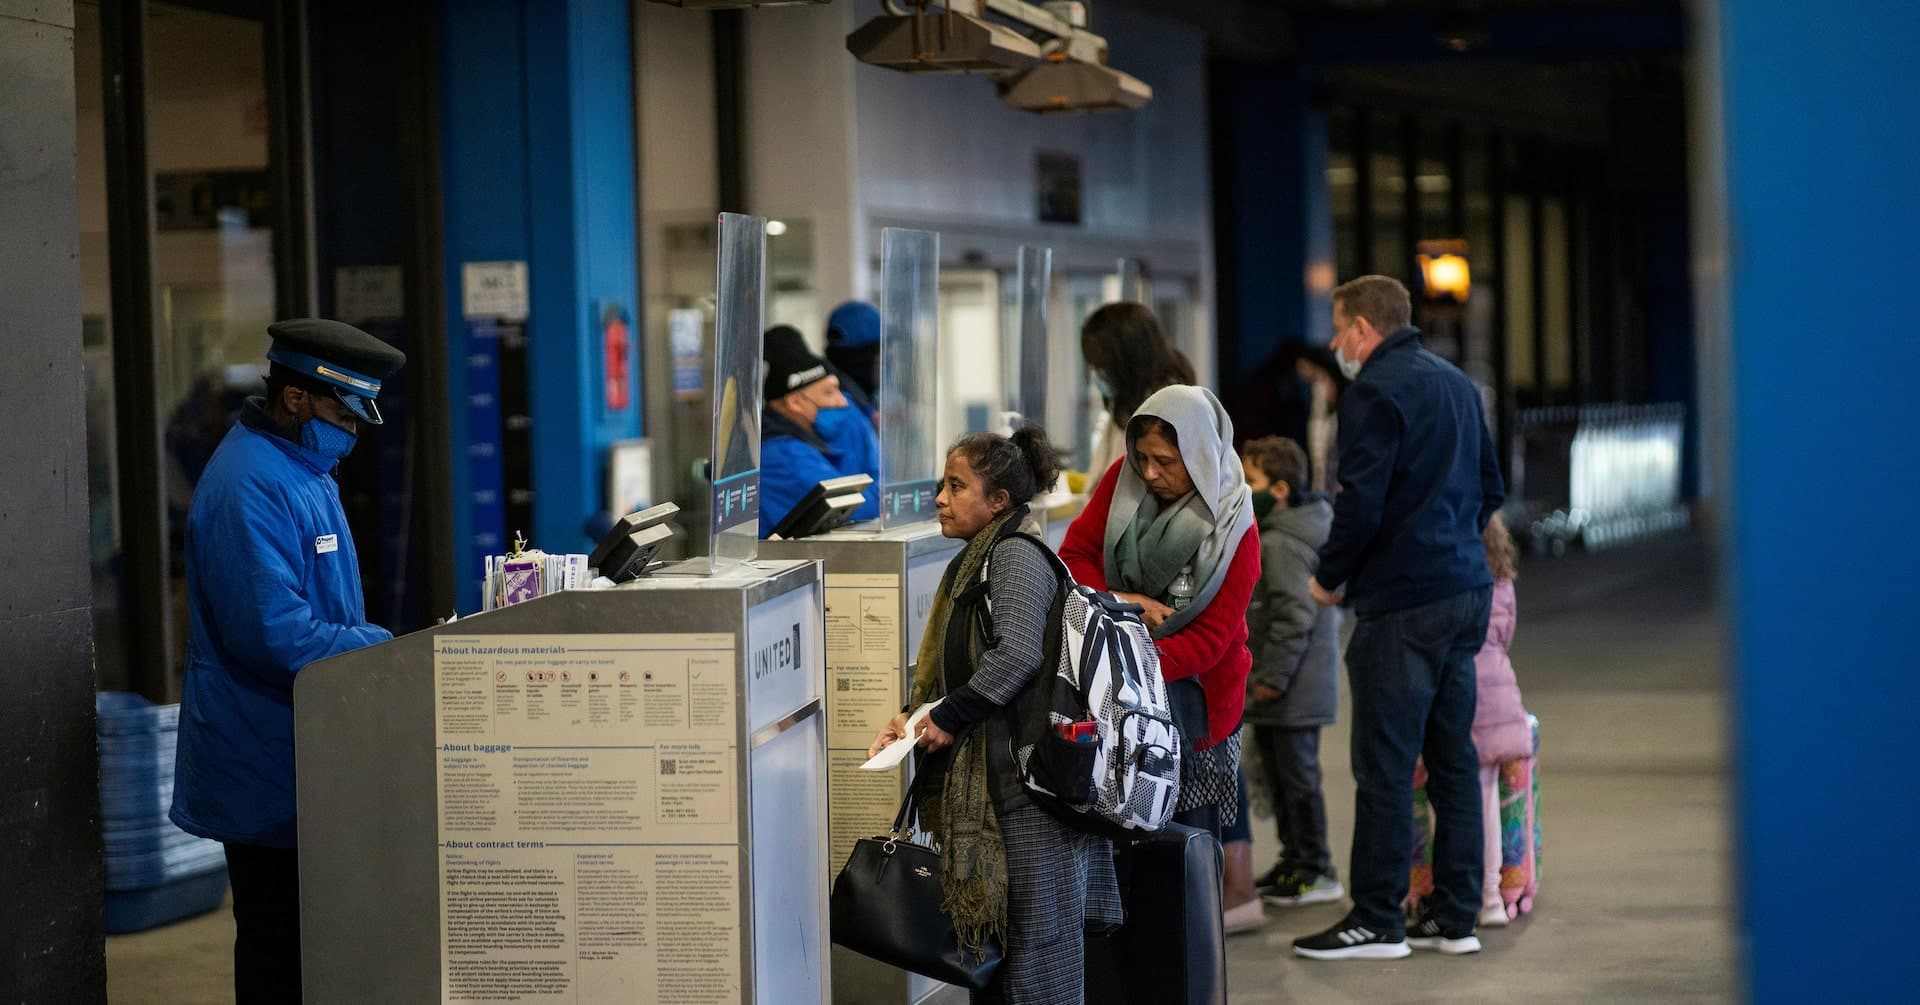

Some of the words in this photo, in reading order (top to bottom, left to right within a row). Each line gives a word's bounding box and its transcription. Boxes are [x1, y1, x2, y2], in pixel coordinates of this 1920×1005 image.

[441, 646, 470, 654] About
[471, 646, 519, 654] hazardous
[521, 646, 566, 654] materials
[754, 637, 791, 680] UNITED
[443, 744, 470, 752] About
[473, 744, 512, 754] baggage
[446, 840, 473, 849] About
[476, 840, 514, 849] contract
[517, 840, 544, 849] terms
